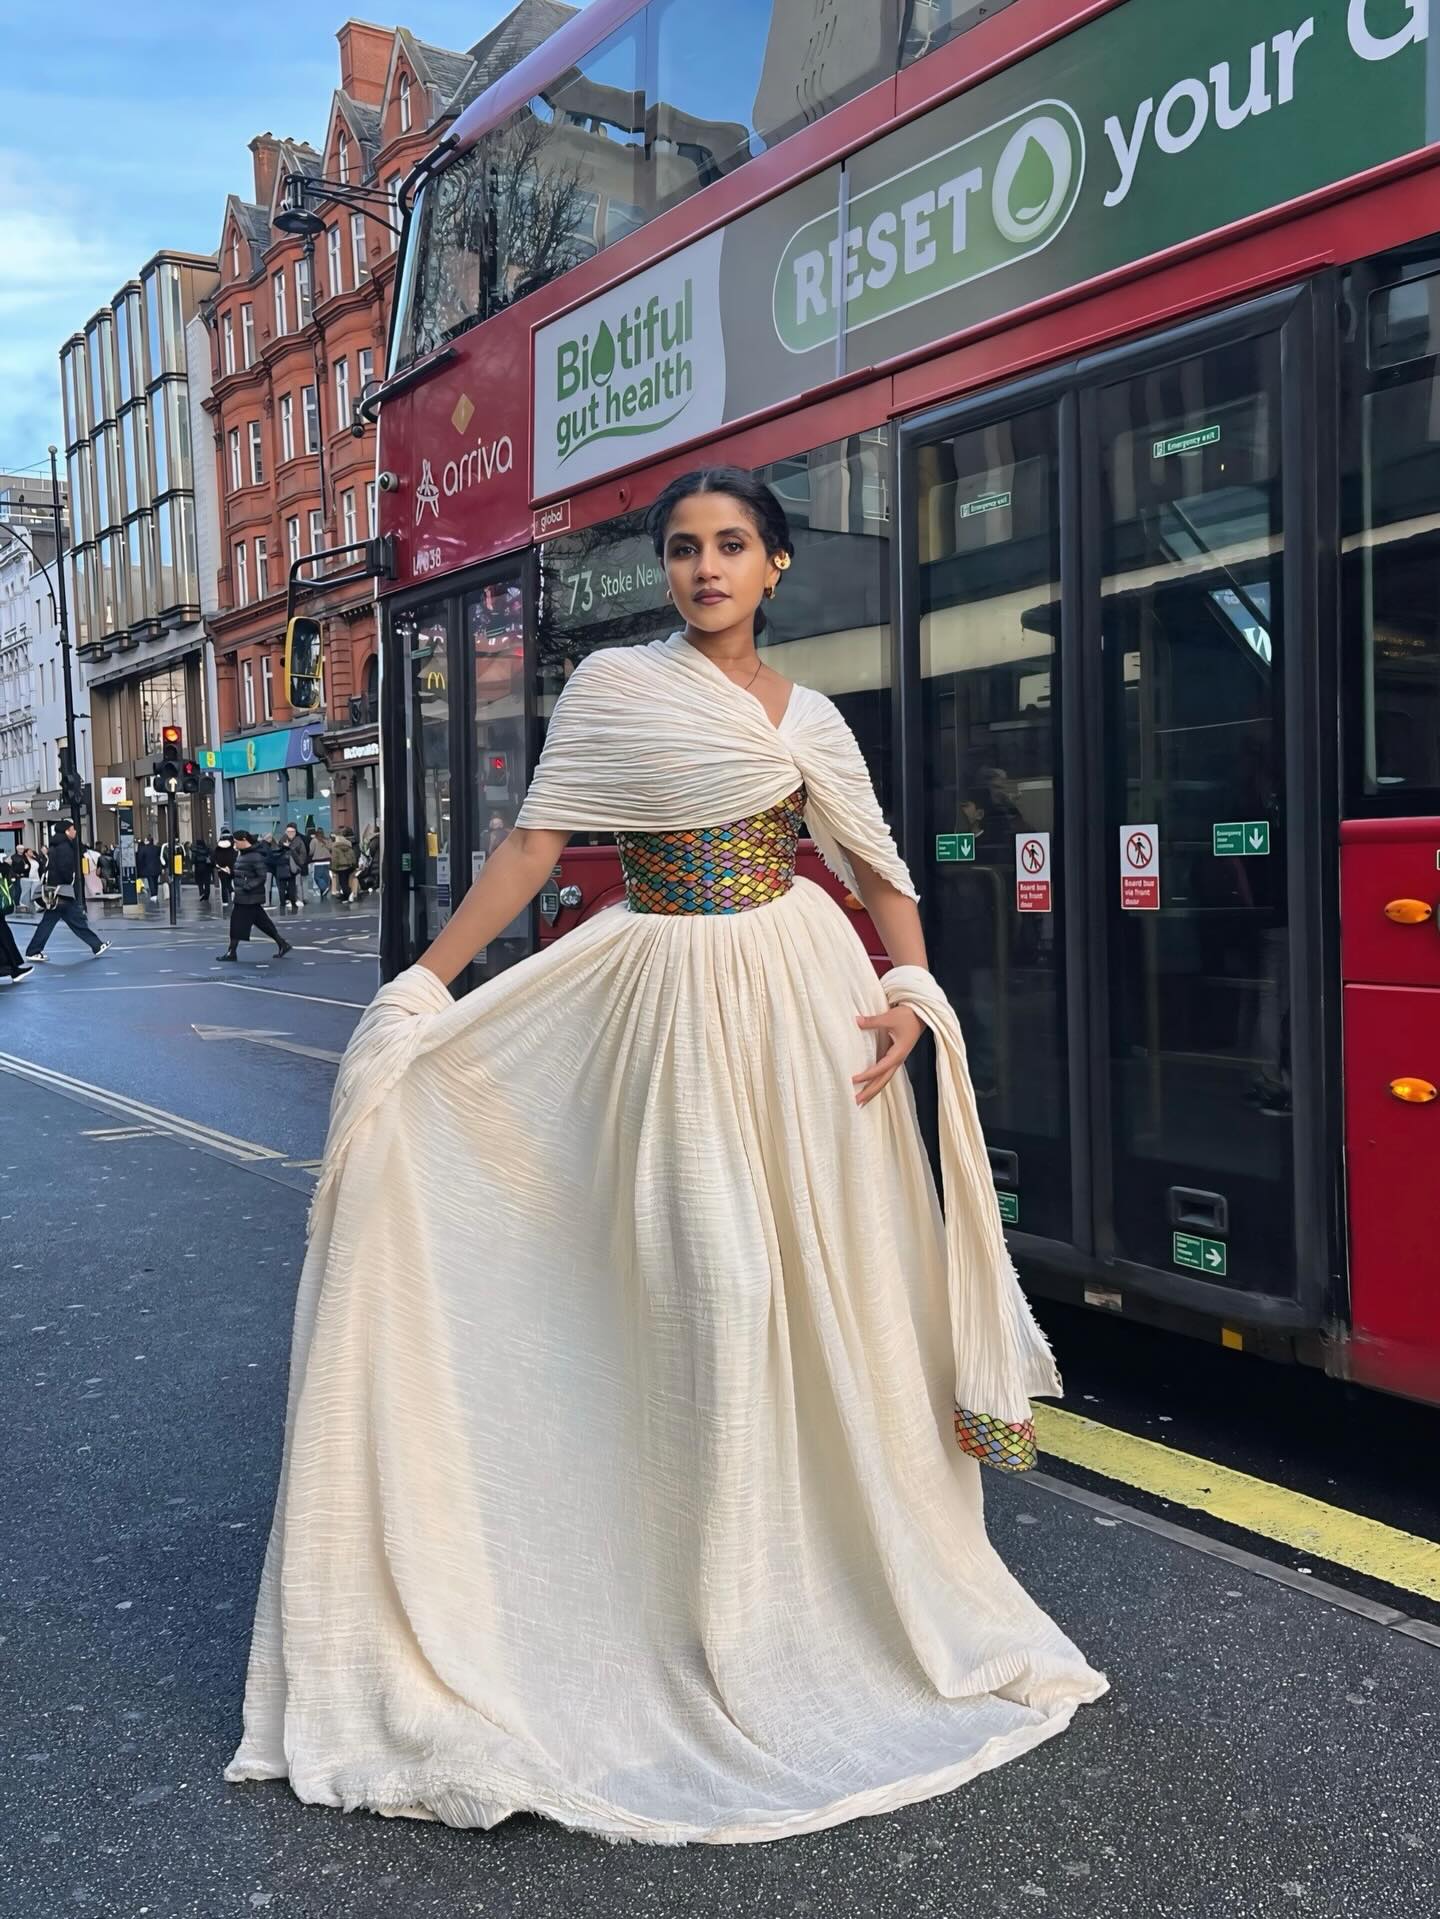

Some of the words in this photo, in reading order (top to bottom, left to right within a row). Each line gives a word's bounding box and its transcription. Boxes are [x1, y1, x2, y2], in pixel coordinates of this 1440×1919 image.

[793, 166, 983, 326] RESET
[1103, 16, 1314, 208] your
[556, 392, 599, 457] gut
[605, 351, 693, 425] health
[443, 435, 513, 497] arriva
[540, 507, 563, 532] global
[568, 570, 593, 615] 73
[601, 569, 632, 598] Stoke
